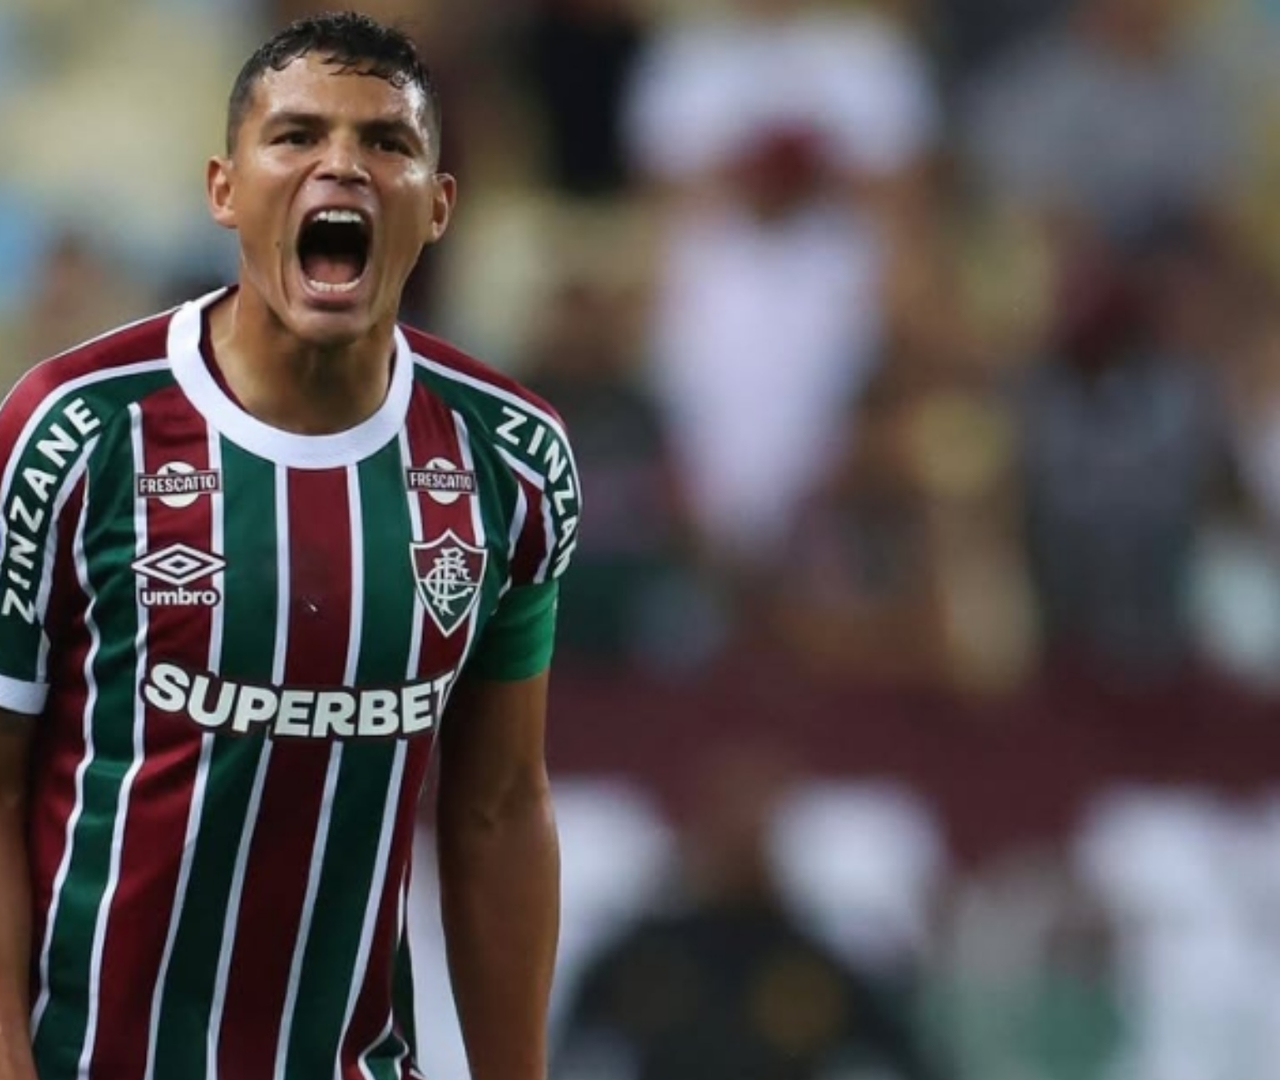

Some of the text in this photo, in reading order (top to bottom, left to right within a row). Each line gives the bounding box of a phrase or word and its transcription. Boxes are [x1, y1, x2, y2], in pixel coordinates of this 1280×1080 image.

[140, 473, 216, 494] FRESCATTO
[1, 398, 101, 625] ZINZANE
[141, 587, 218, 606] umbro
